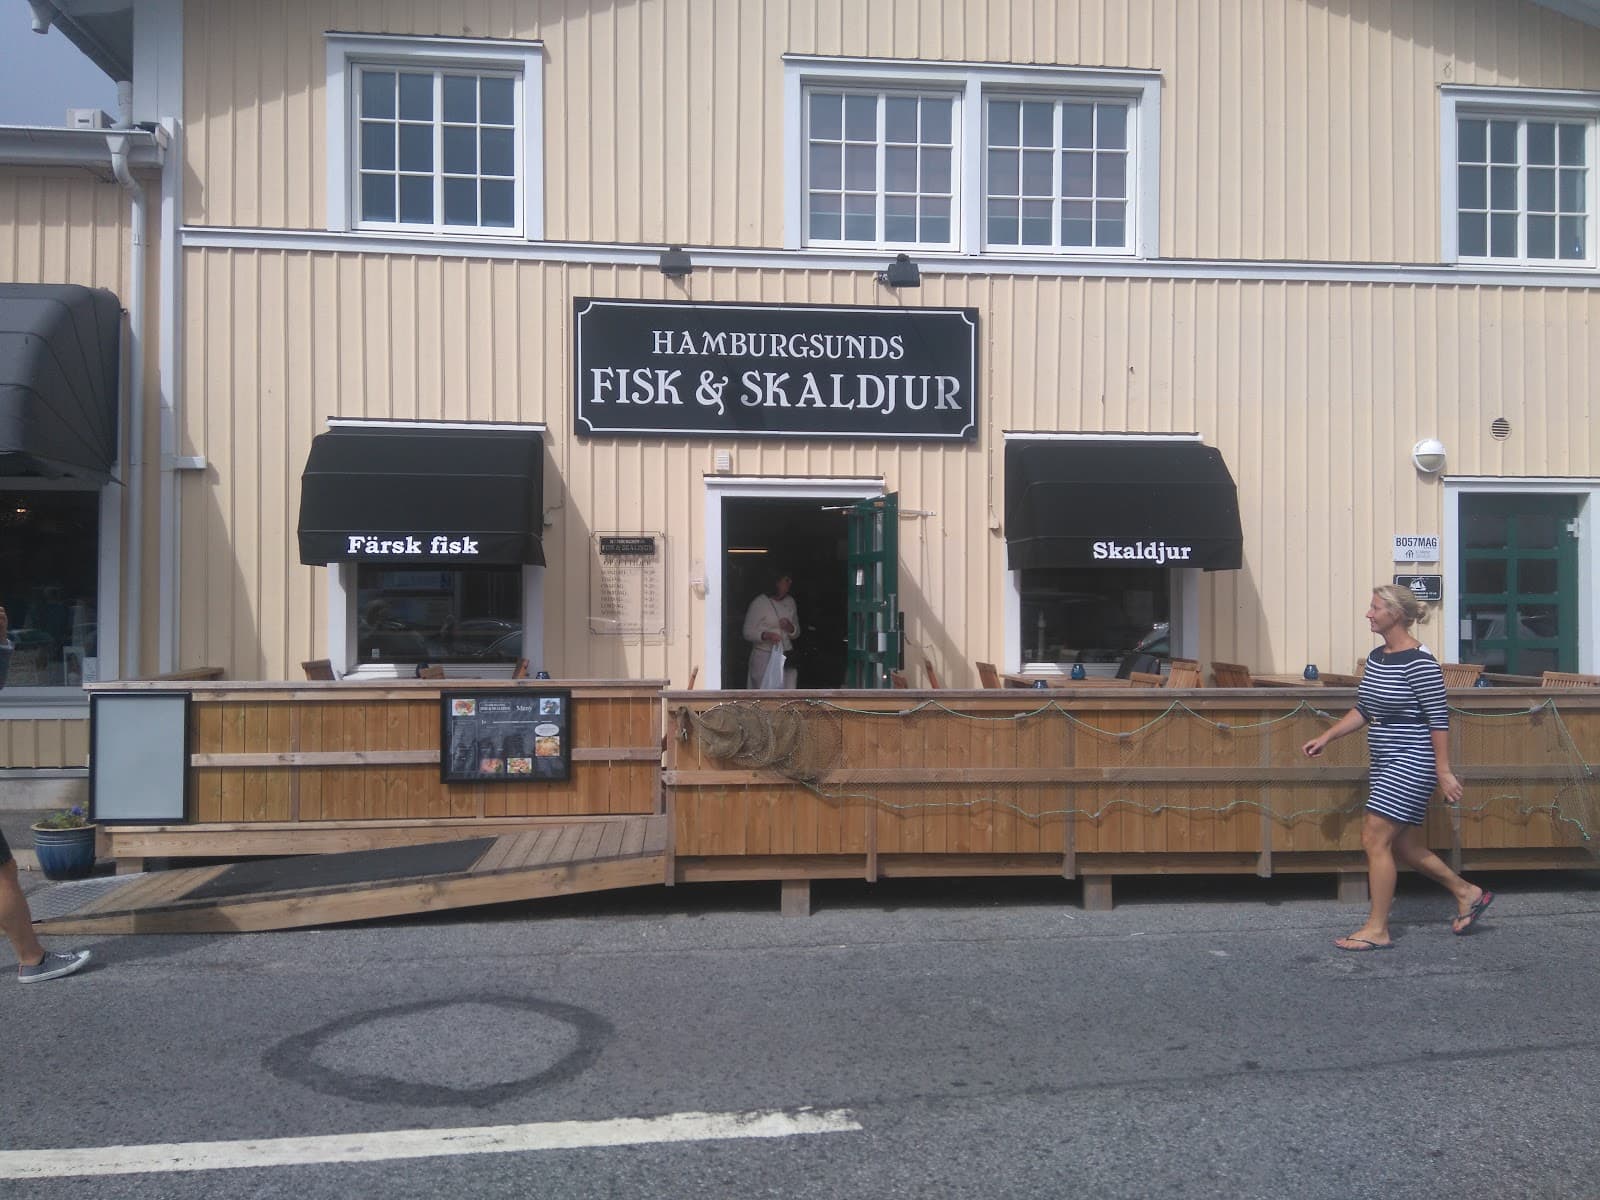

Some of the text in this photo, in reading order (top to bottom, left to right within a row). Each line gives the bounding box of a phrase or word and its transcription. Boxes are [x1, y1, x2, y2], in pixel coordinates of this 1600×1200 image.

[652, 330, 904, 359] HAMBURGSUNDS
[590, 366, 962, 415] FISK & SKALDJUR
[347, 535, 479, 554] Färsk fisk
[1093, 541, 1191, 564] Skaldjur
